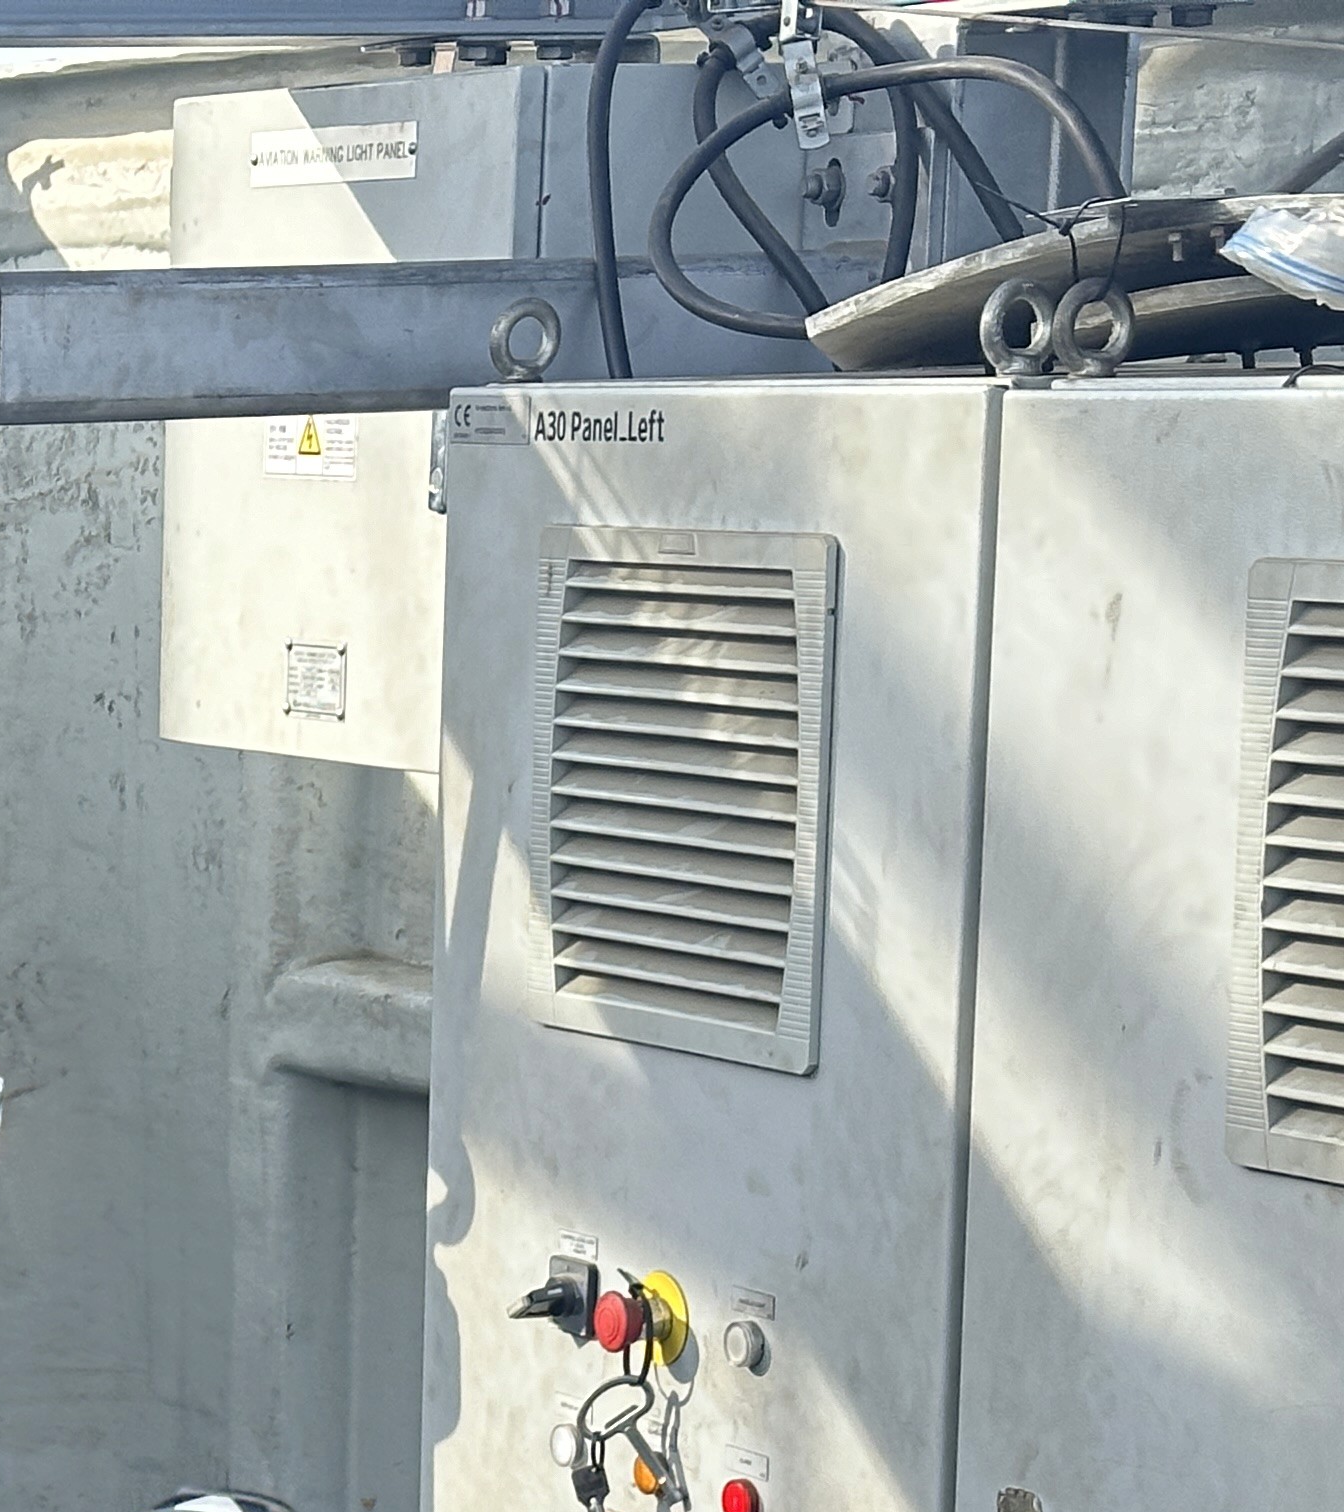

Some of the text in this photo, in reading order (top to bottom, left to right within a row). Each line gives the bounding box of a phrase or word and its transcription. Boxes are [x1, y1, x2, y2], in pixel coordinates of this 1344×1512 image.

[259, 140, 409, 166] AVIATION WARNING LIGHT PANEL
[534, 409, 665, 442] A30 Panel_Left
